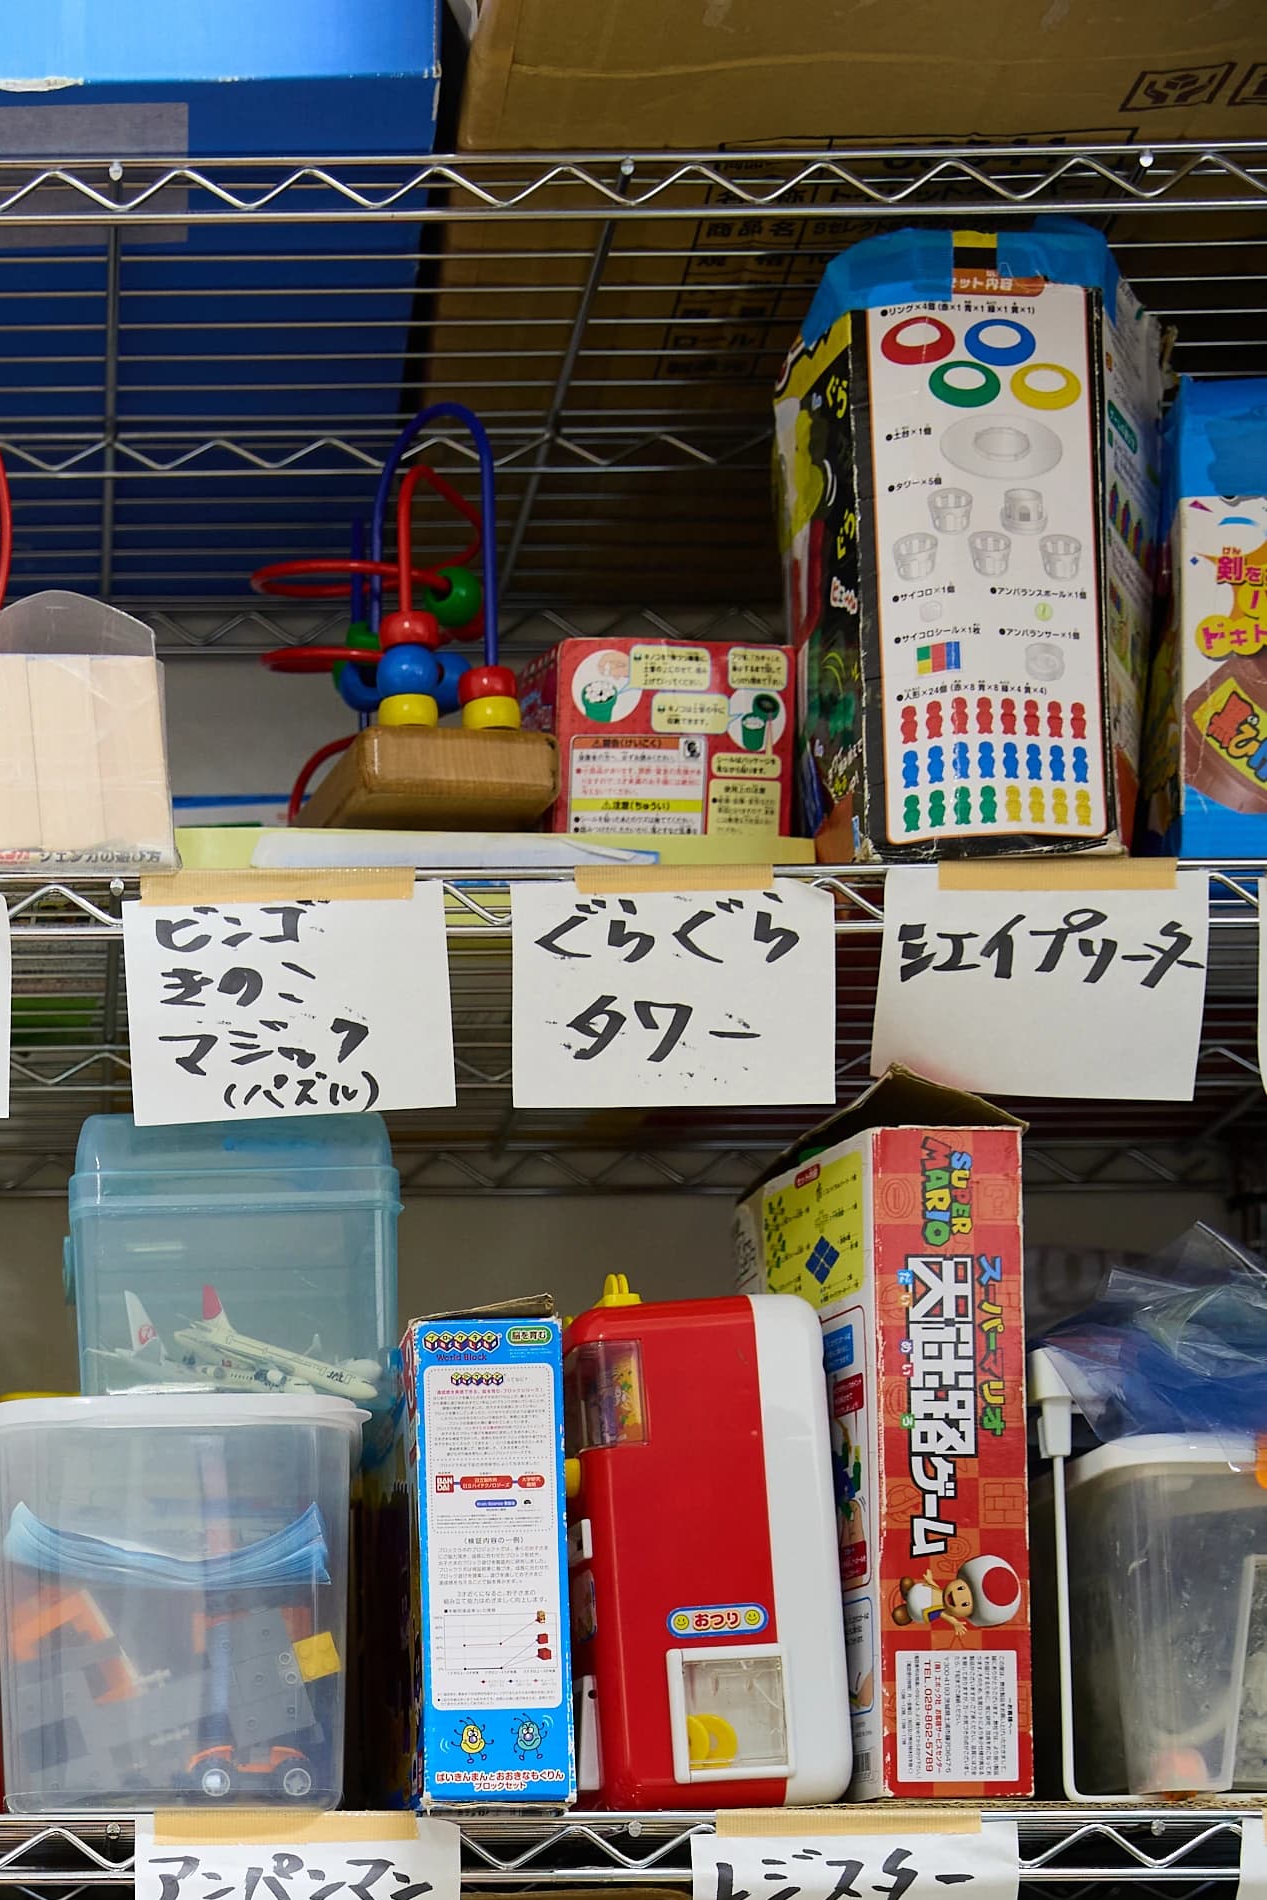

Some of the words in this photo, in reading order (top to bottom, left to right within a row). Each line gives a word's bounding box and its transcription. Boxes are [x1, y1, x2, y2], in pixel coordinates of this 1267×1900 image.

[706, 220, 796, 239] 商品名
[613, 801, 670, 810] 注意(ちゅうい)
[155, 899, 331, 953] ビンゴ
[534, 892, 800, 964] ぐらぐら
[160, 960, 317, 1007] きのこ
[566, 994, 762, 1062] タワー
[159, 1016, 370, 1077] マジック
[224, 1069, 380, 1112] (パズル)
[921, 1135, 953, 1247] MARIO
[949, 1150, 973, 1236] SUPER
[512, 1331, 546, 1340] 脳を育む
[978, 1255, 1006, 1436] スーパーマリオ
[437, 1353, 462, 1361] World
[464, 1353, 487, 1361] Block
[436, 1475, 453, 1484] BAN
[436, 1484, 451, 1492] DAI
[692, 1610, 742, 1630] おつり
[436, 1770, 564, 1783] ばいきんまんとおおきなもぐりん
[474, 1782, 527, 1791] ブロックセット
